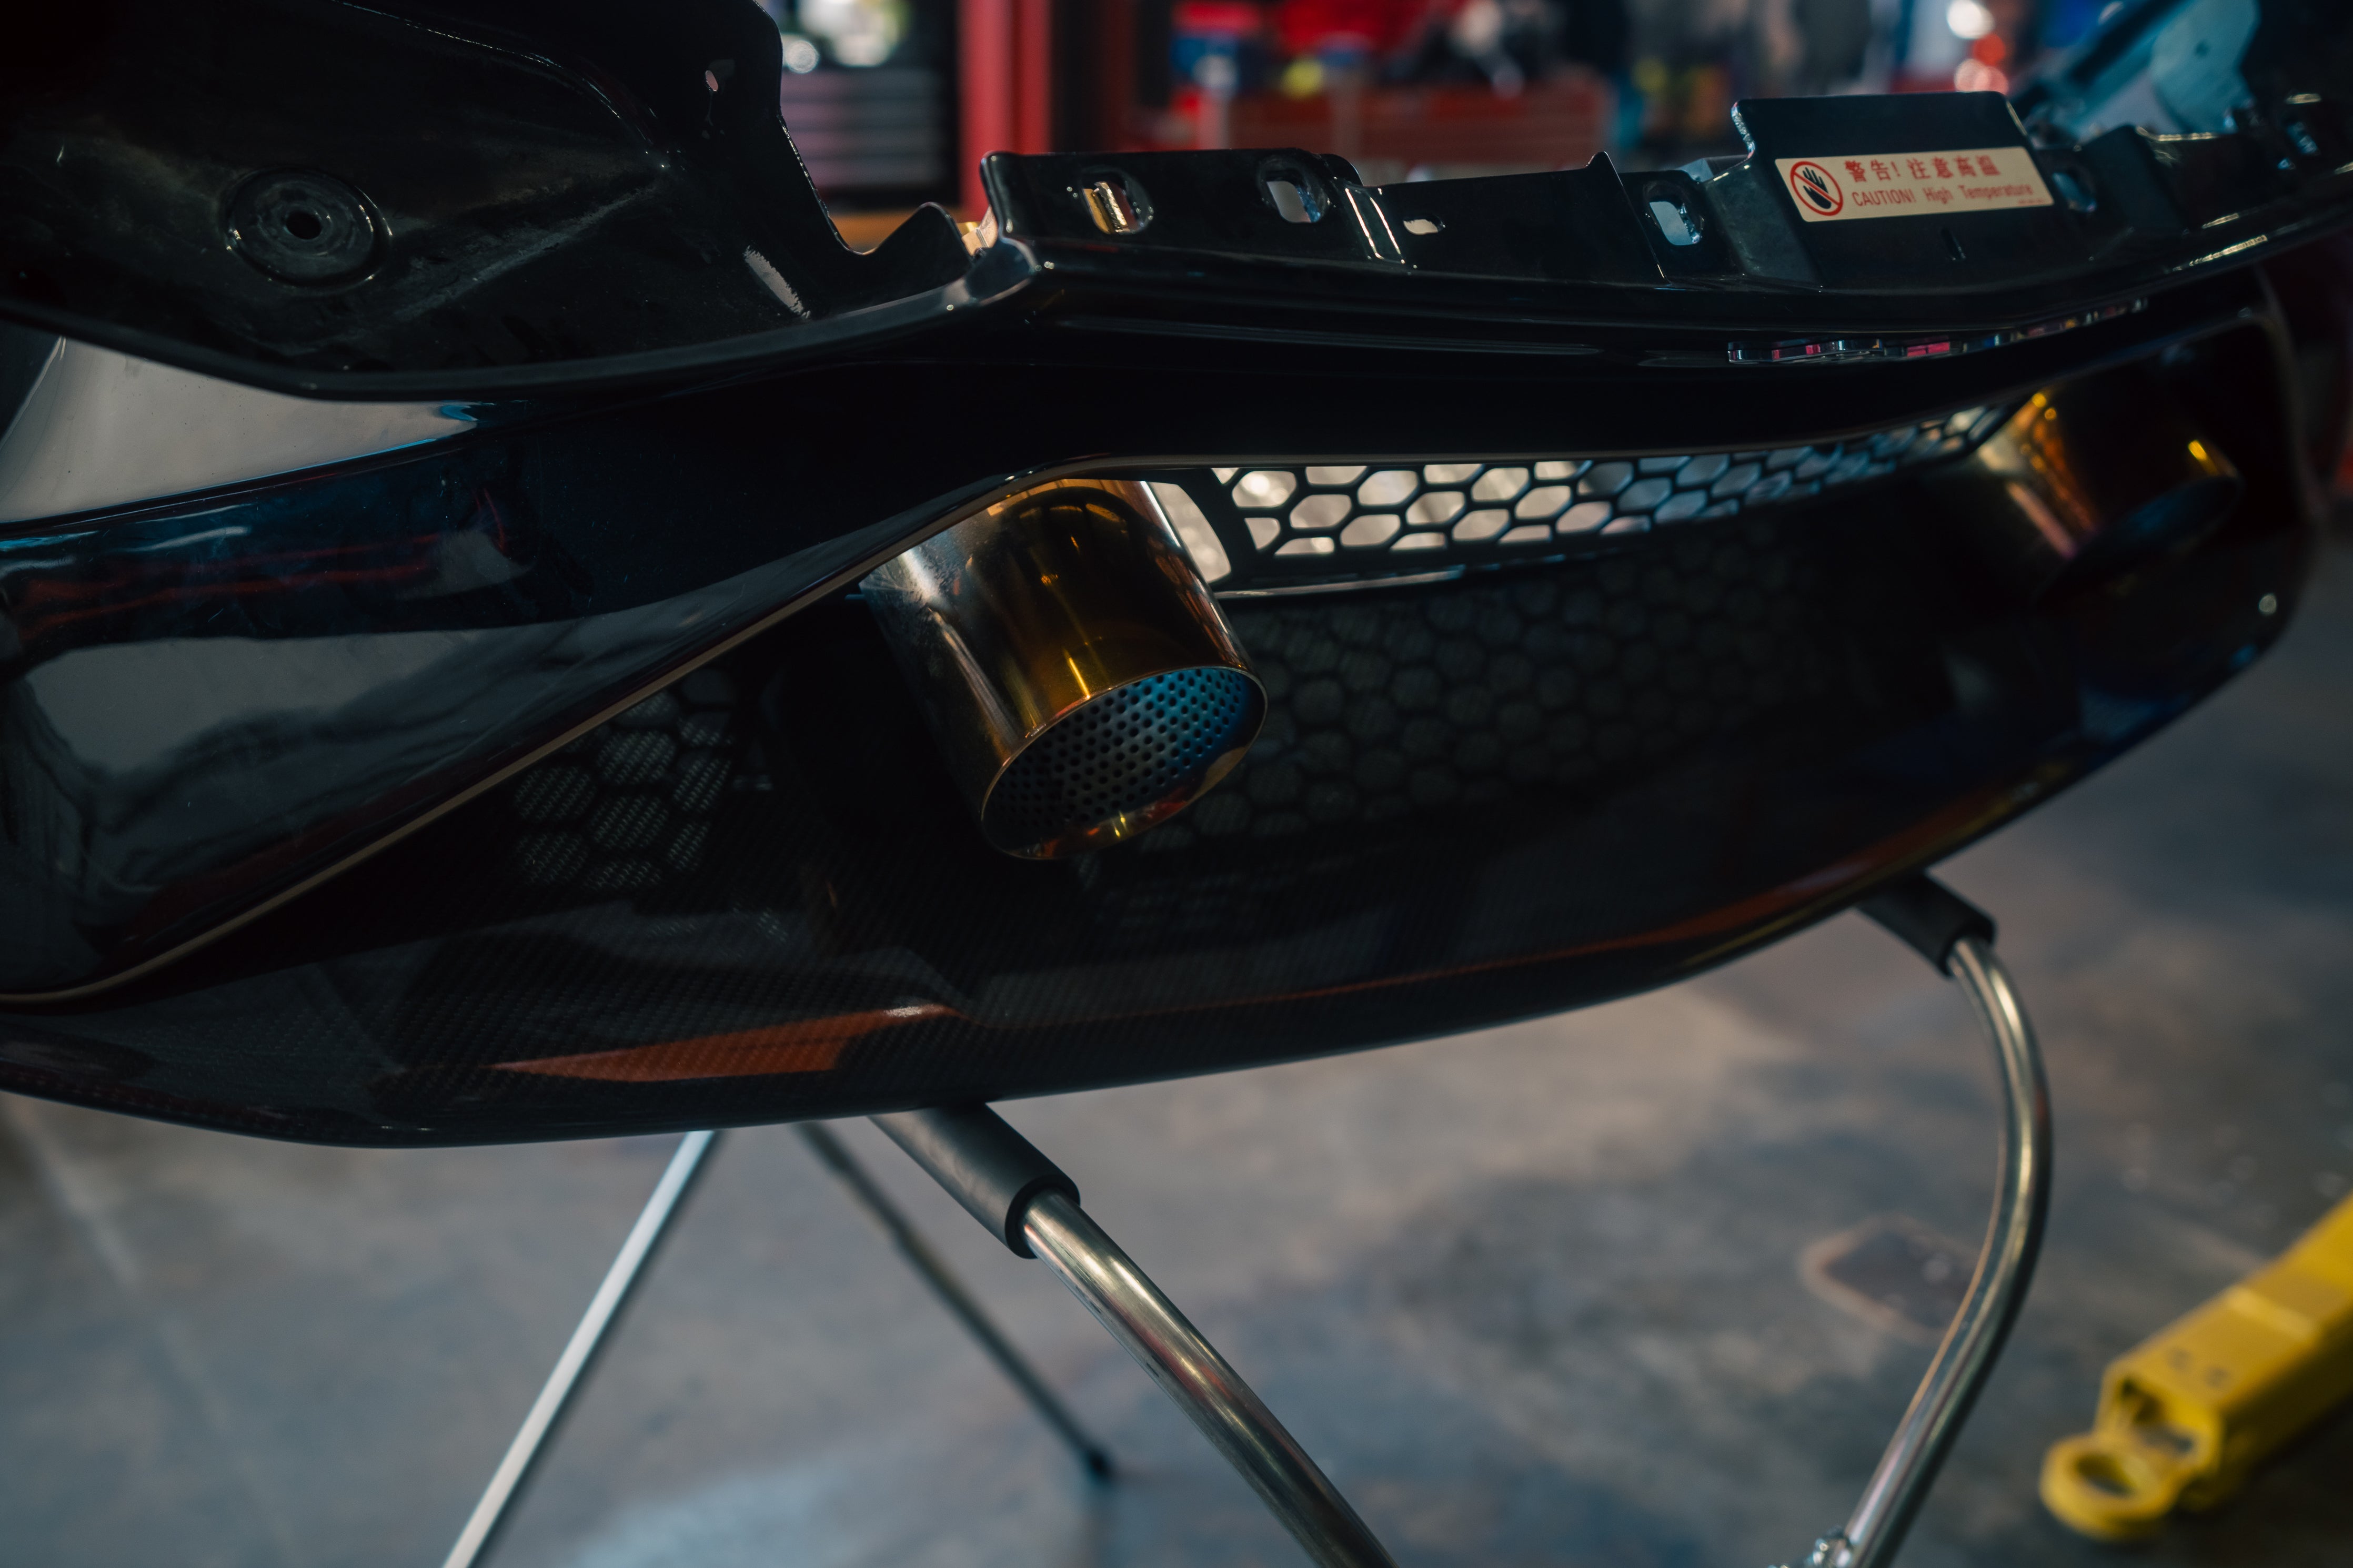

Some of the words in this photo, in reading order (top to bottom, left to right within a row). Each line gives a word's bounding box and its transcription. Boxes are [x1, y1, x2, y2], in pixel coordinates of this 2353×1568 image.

[1852, 189, 1915, 206] CAUTION!
[1922, 187, 1953, 205] High
[1958, 184, 2034, 199] Temperature
